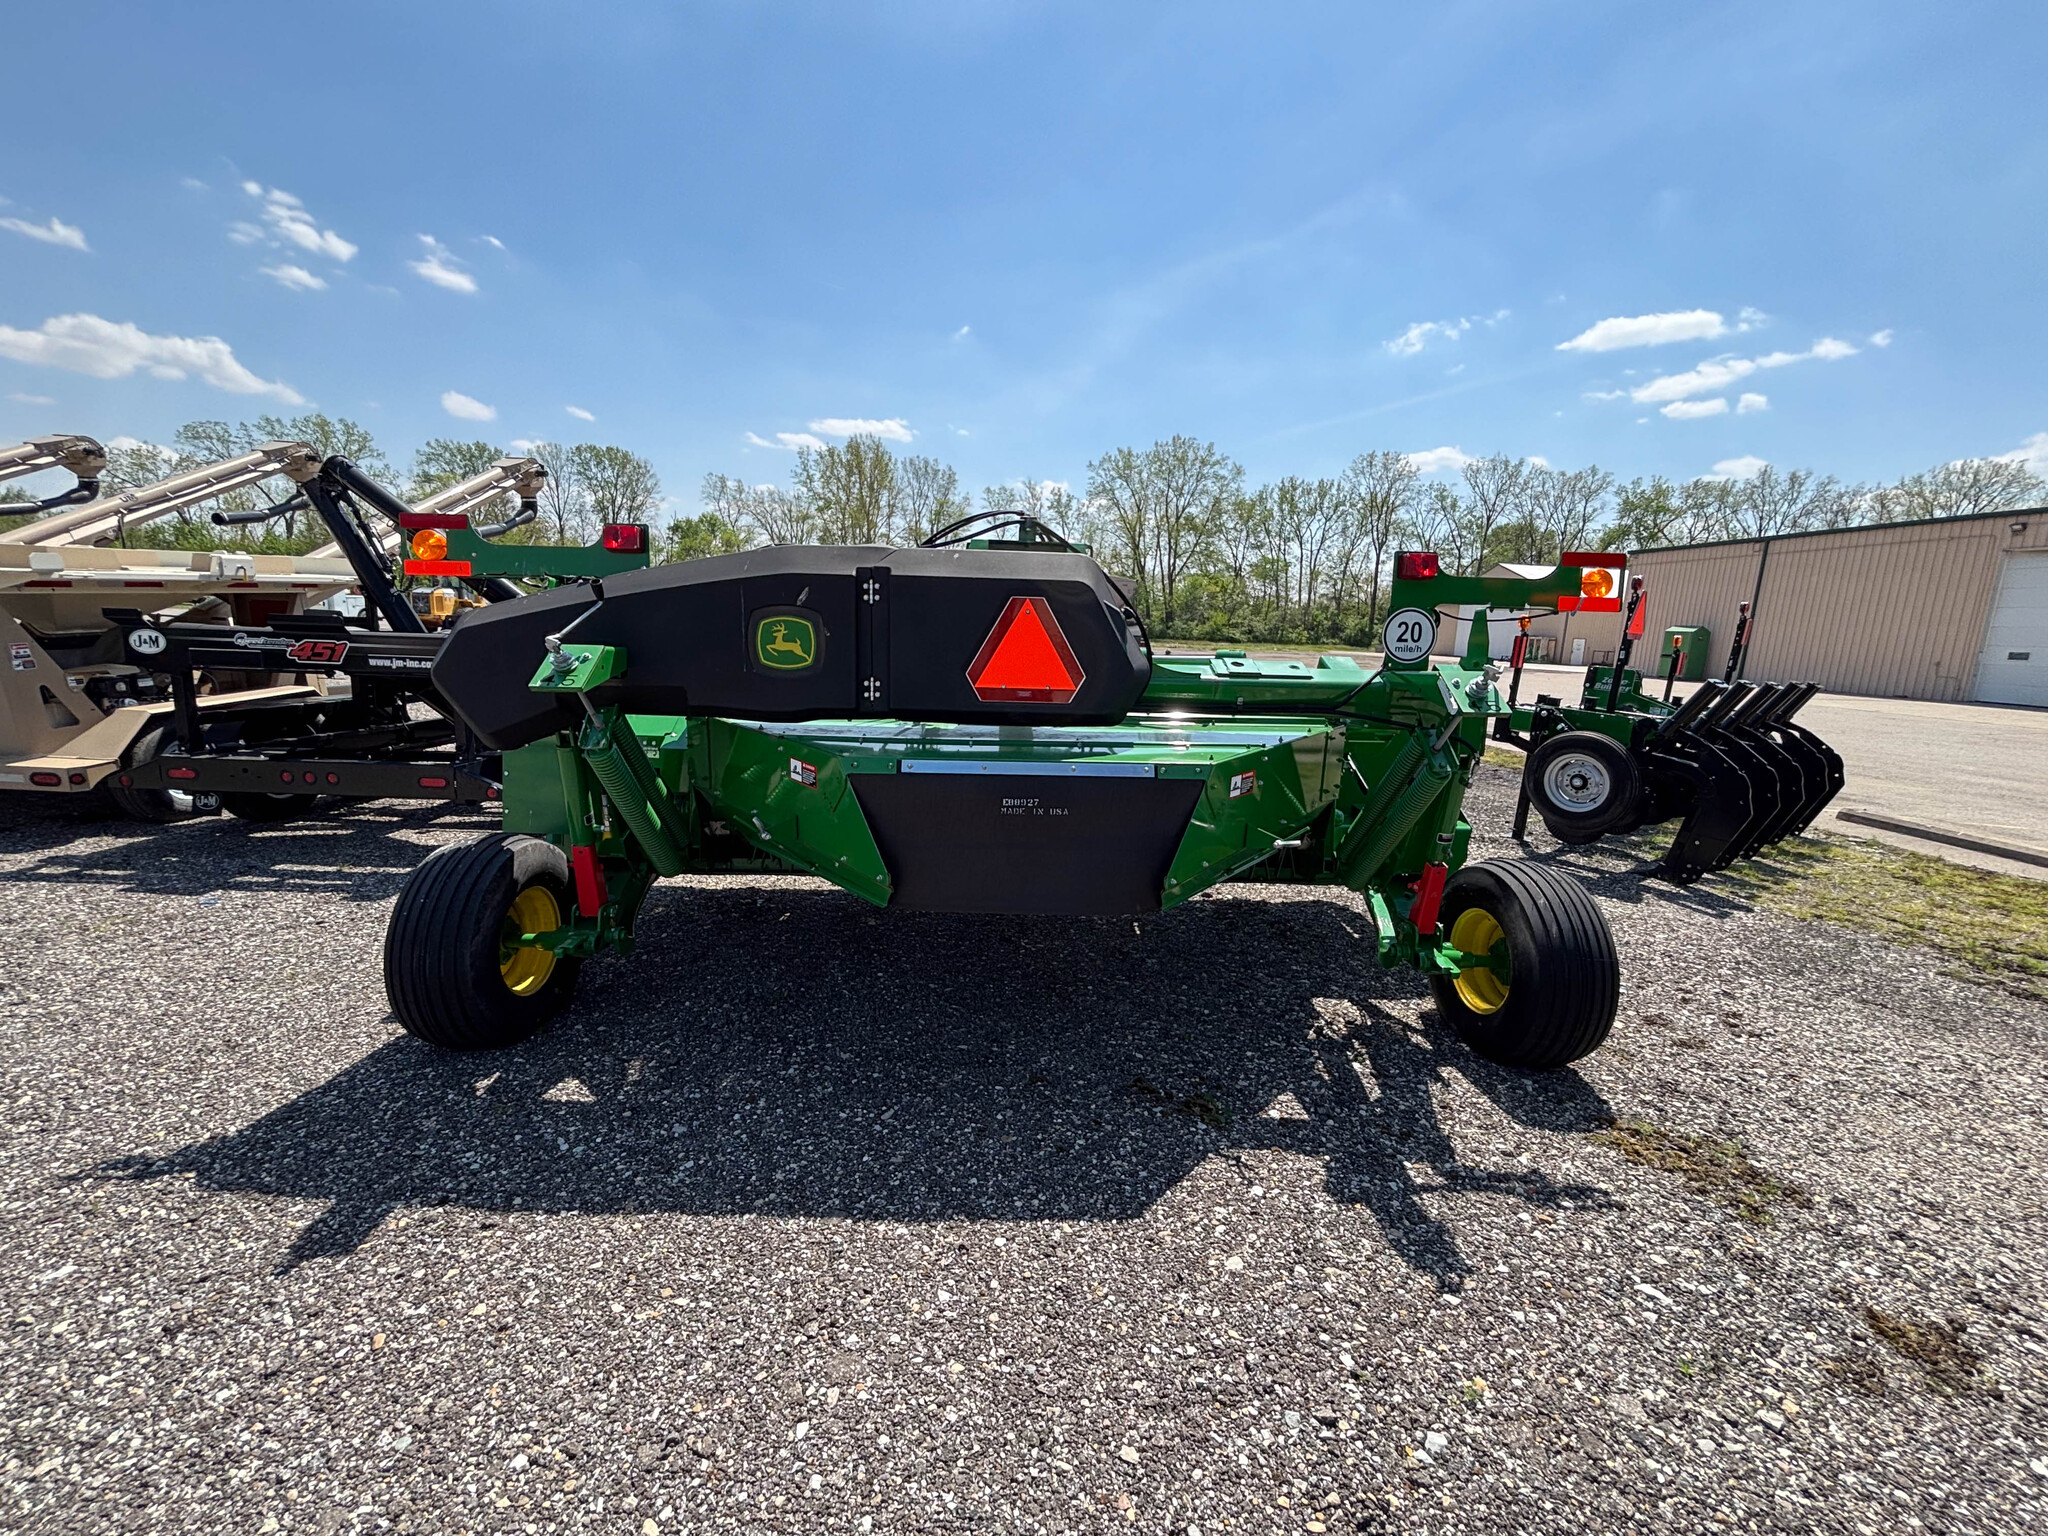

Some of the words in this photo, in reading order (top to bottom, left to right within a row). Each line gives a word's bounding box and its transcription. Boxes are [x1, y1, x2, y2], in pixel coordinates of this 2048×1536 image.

[1396, 621, 1422, 643] 20
[133, 634, 160, 649] J&M
[290, 642, 346, 661] 451
[1394, 644, 1422, 653] mile/h
[368, 658, 433, 669] www.jm-inc.co
[1593, 682, 1632, 693] Builer
[1000, 807, 1026, 815] MADE
[1049, 808, 1069, 816] USA
